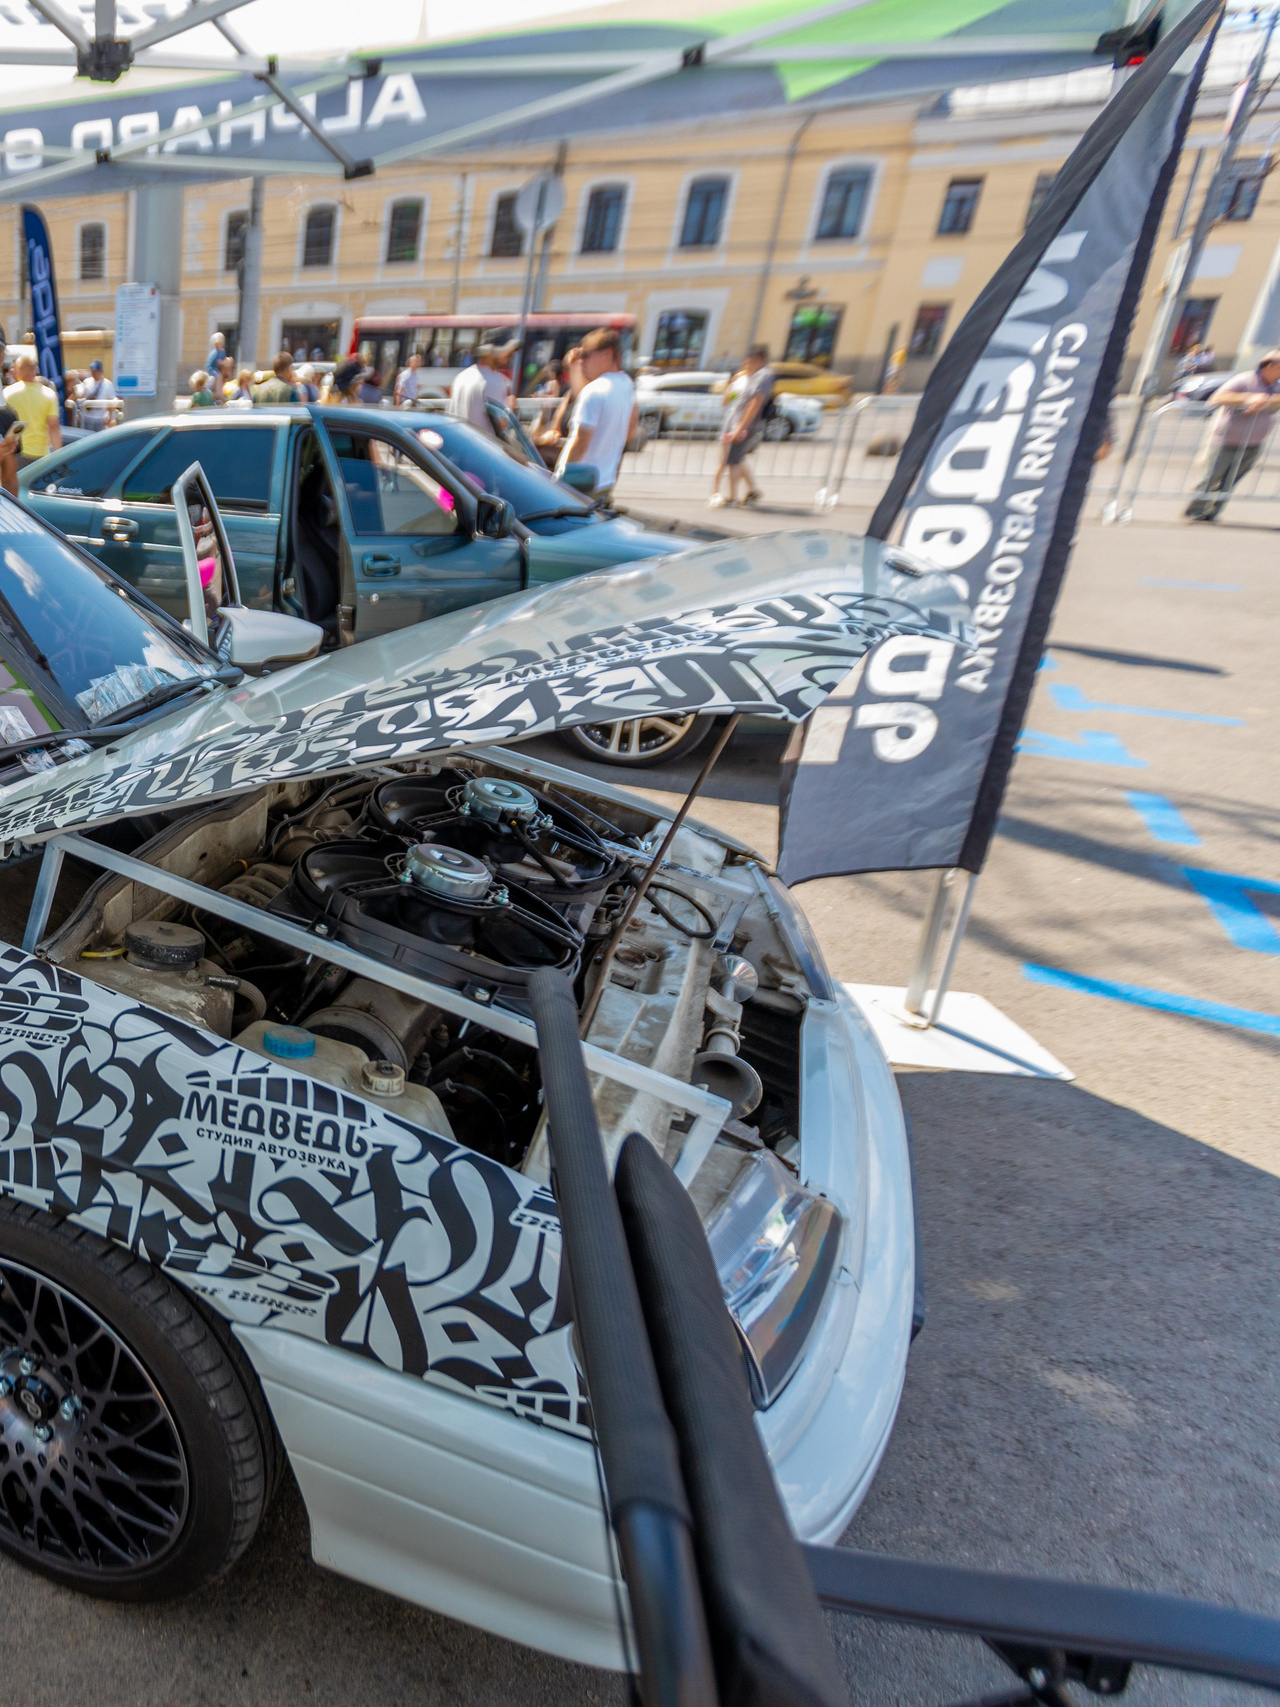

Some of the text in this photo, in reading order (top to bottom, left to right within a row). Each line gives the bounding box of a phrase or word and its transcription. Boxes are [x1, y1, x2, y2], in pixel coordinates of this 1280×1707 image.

[504, 631, 719, 683] МЕДВЕДЬ
[184, 1090, 369, 1159] МЕДВЕДЬ
[196, 1127, 347, 1171] СТУДИЯ АВТОЗВУКА
